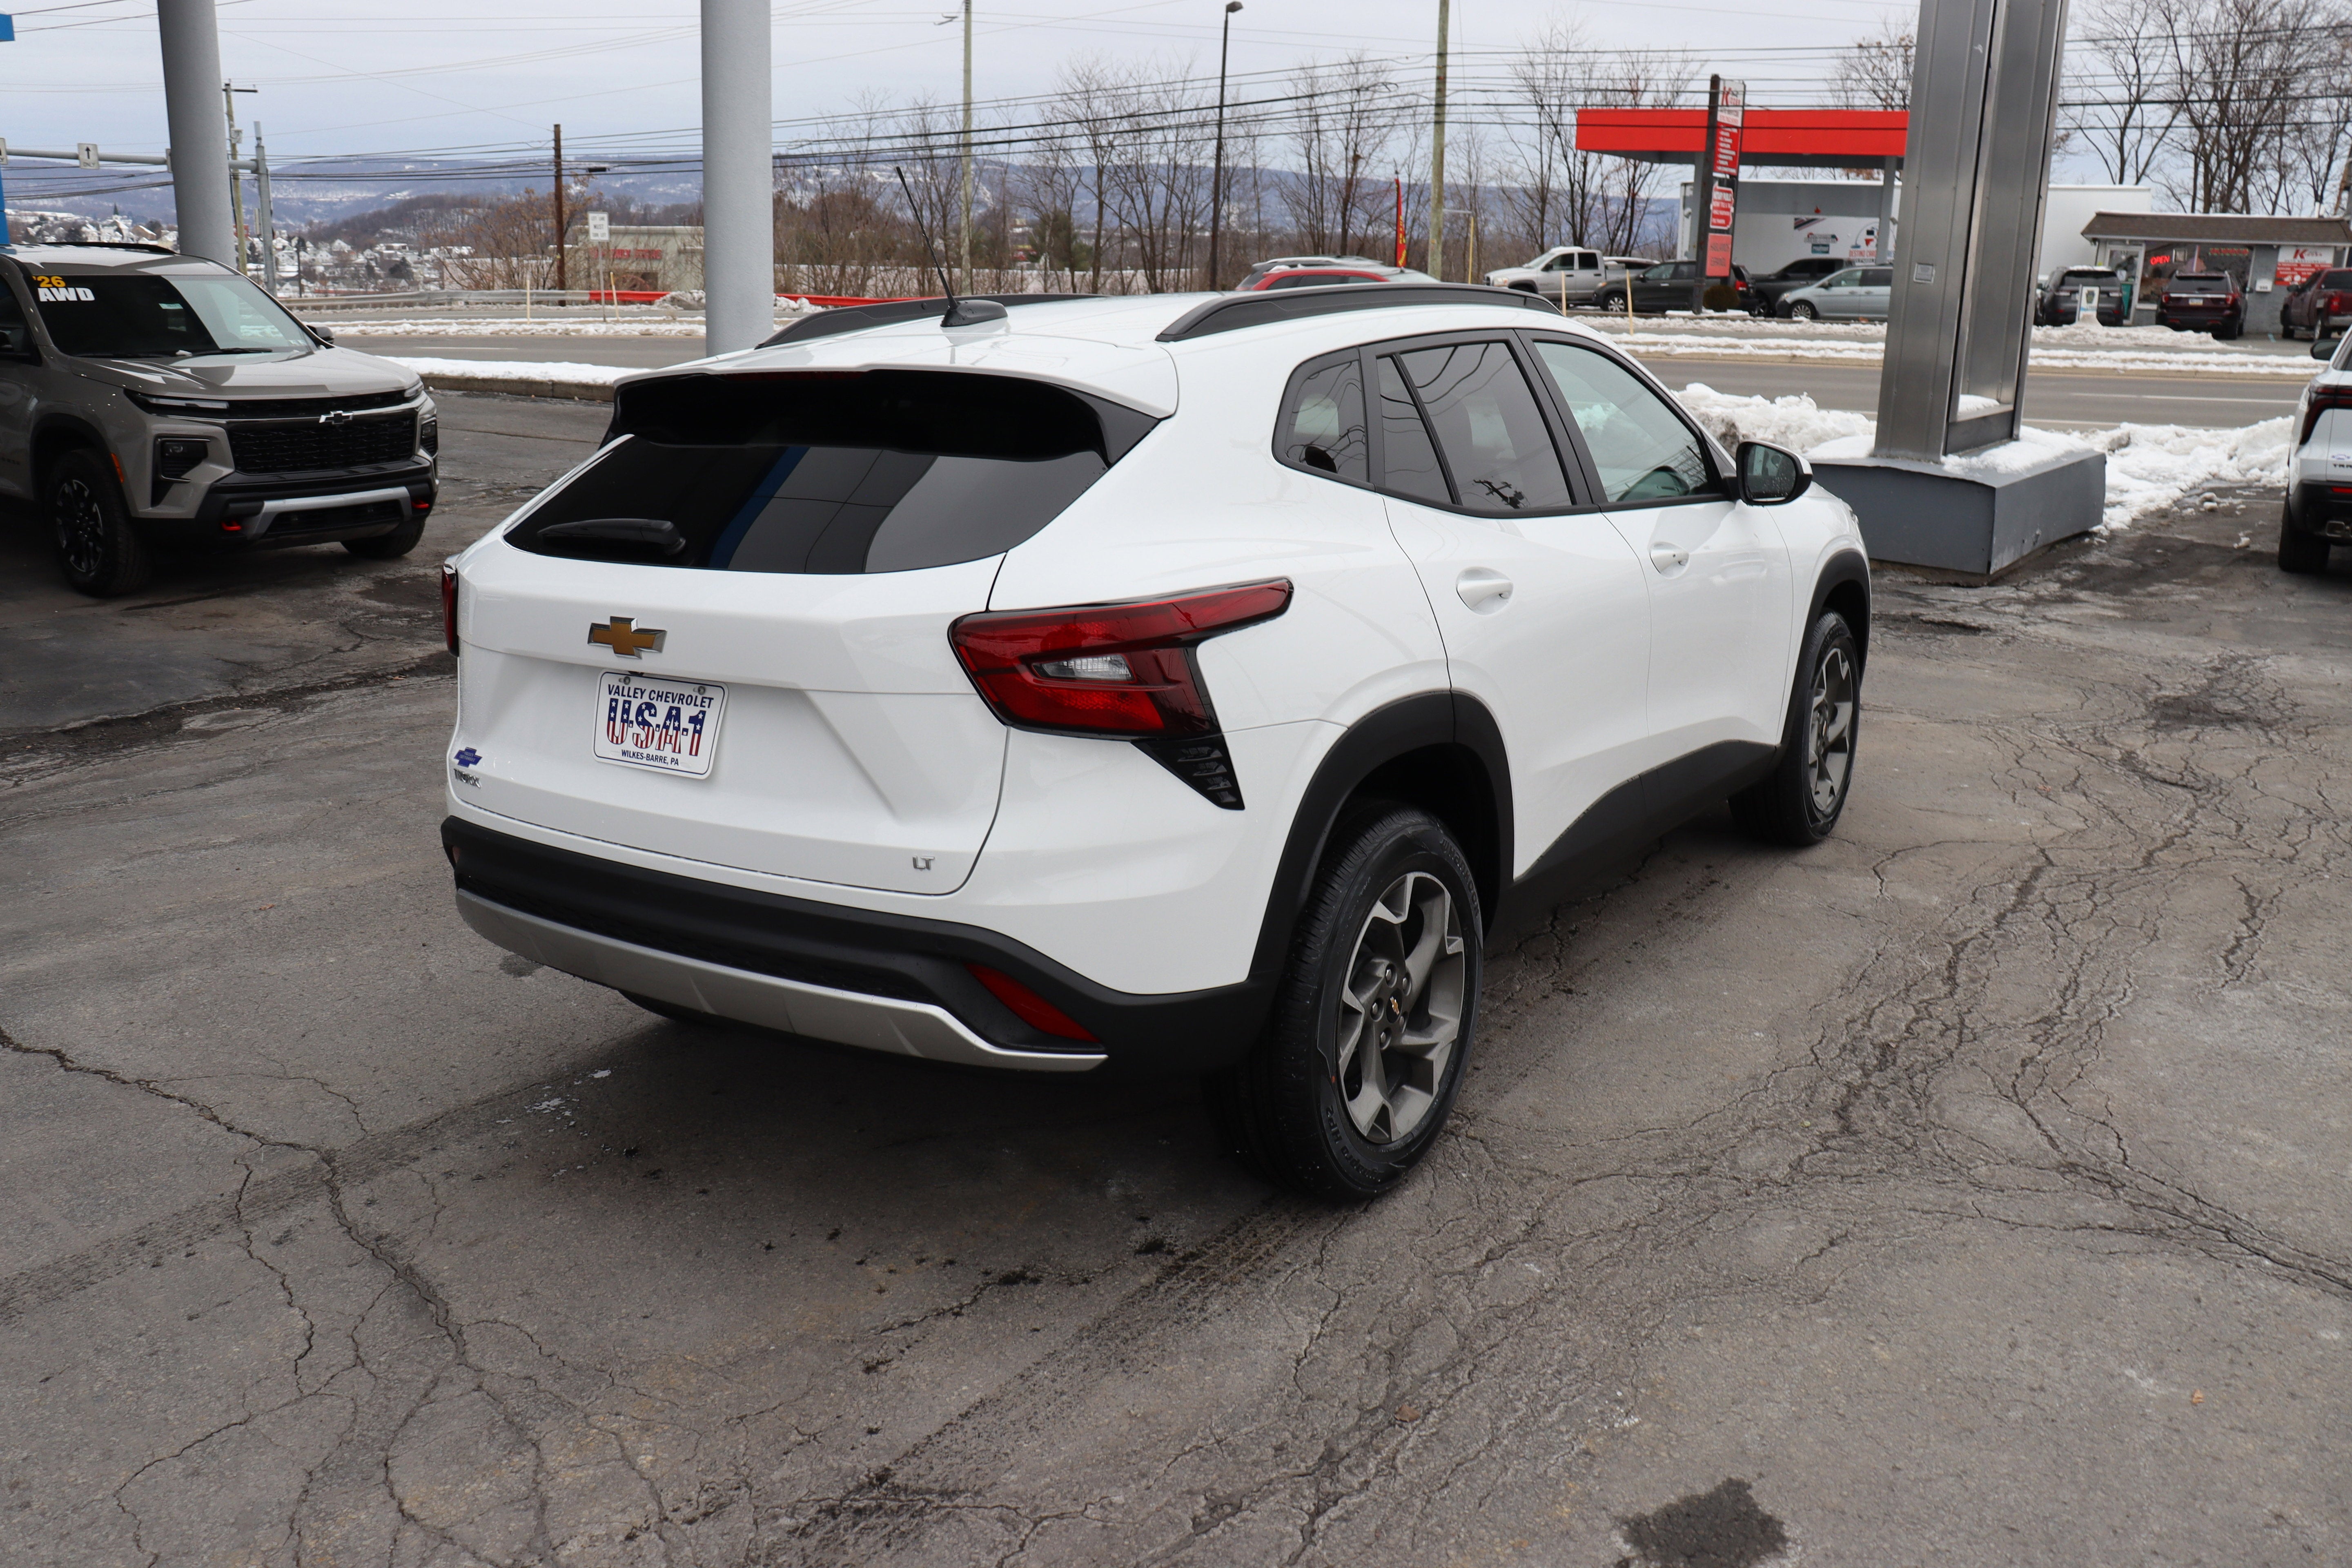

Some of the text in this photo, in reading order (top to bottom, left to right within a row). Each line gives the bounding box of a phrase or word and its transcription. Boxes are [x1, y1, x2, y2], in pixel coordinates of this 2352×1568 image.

[2150, 255, 2170, 265] OPEN
[32, 276, 66, 287] '26
[38, 287, 95, 302] AWD
[608, 684, 714, 708] VALLEY CHEVROLET
[621, 749, 679, 766] WILKES-BARRE, PA
[912, 855, 935, 871] LT
[1326, 1105, 1343, 1144] HP2
